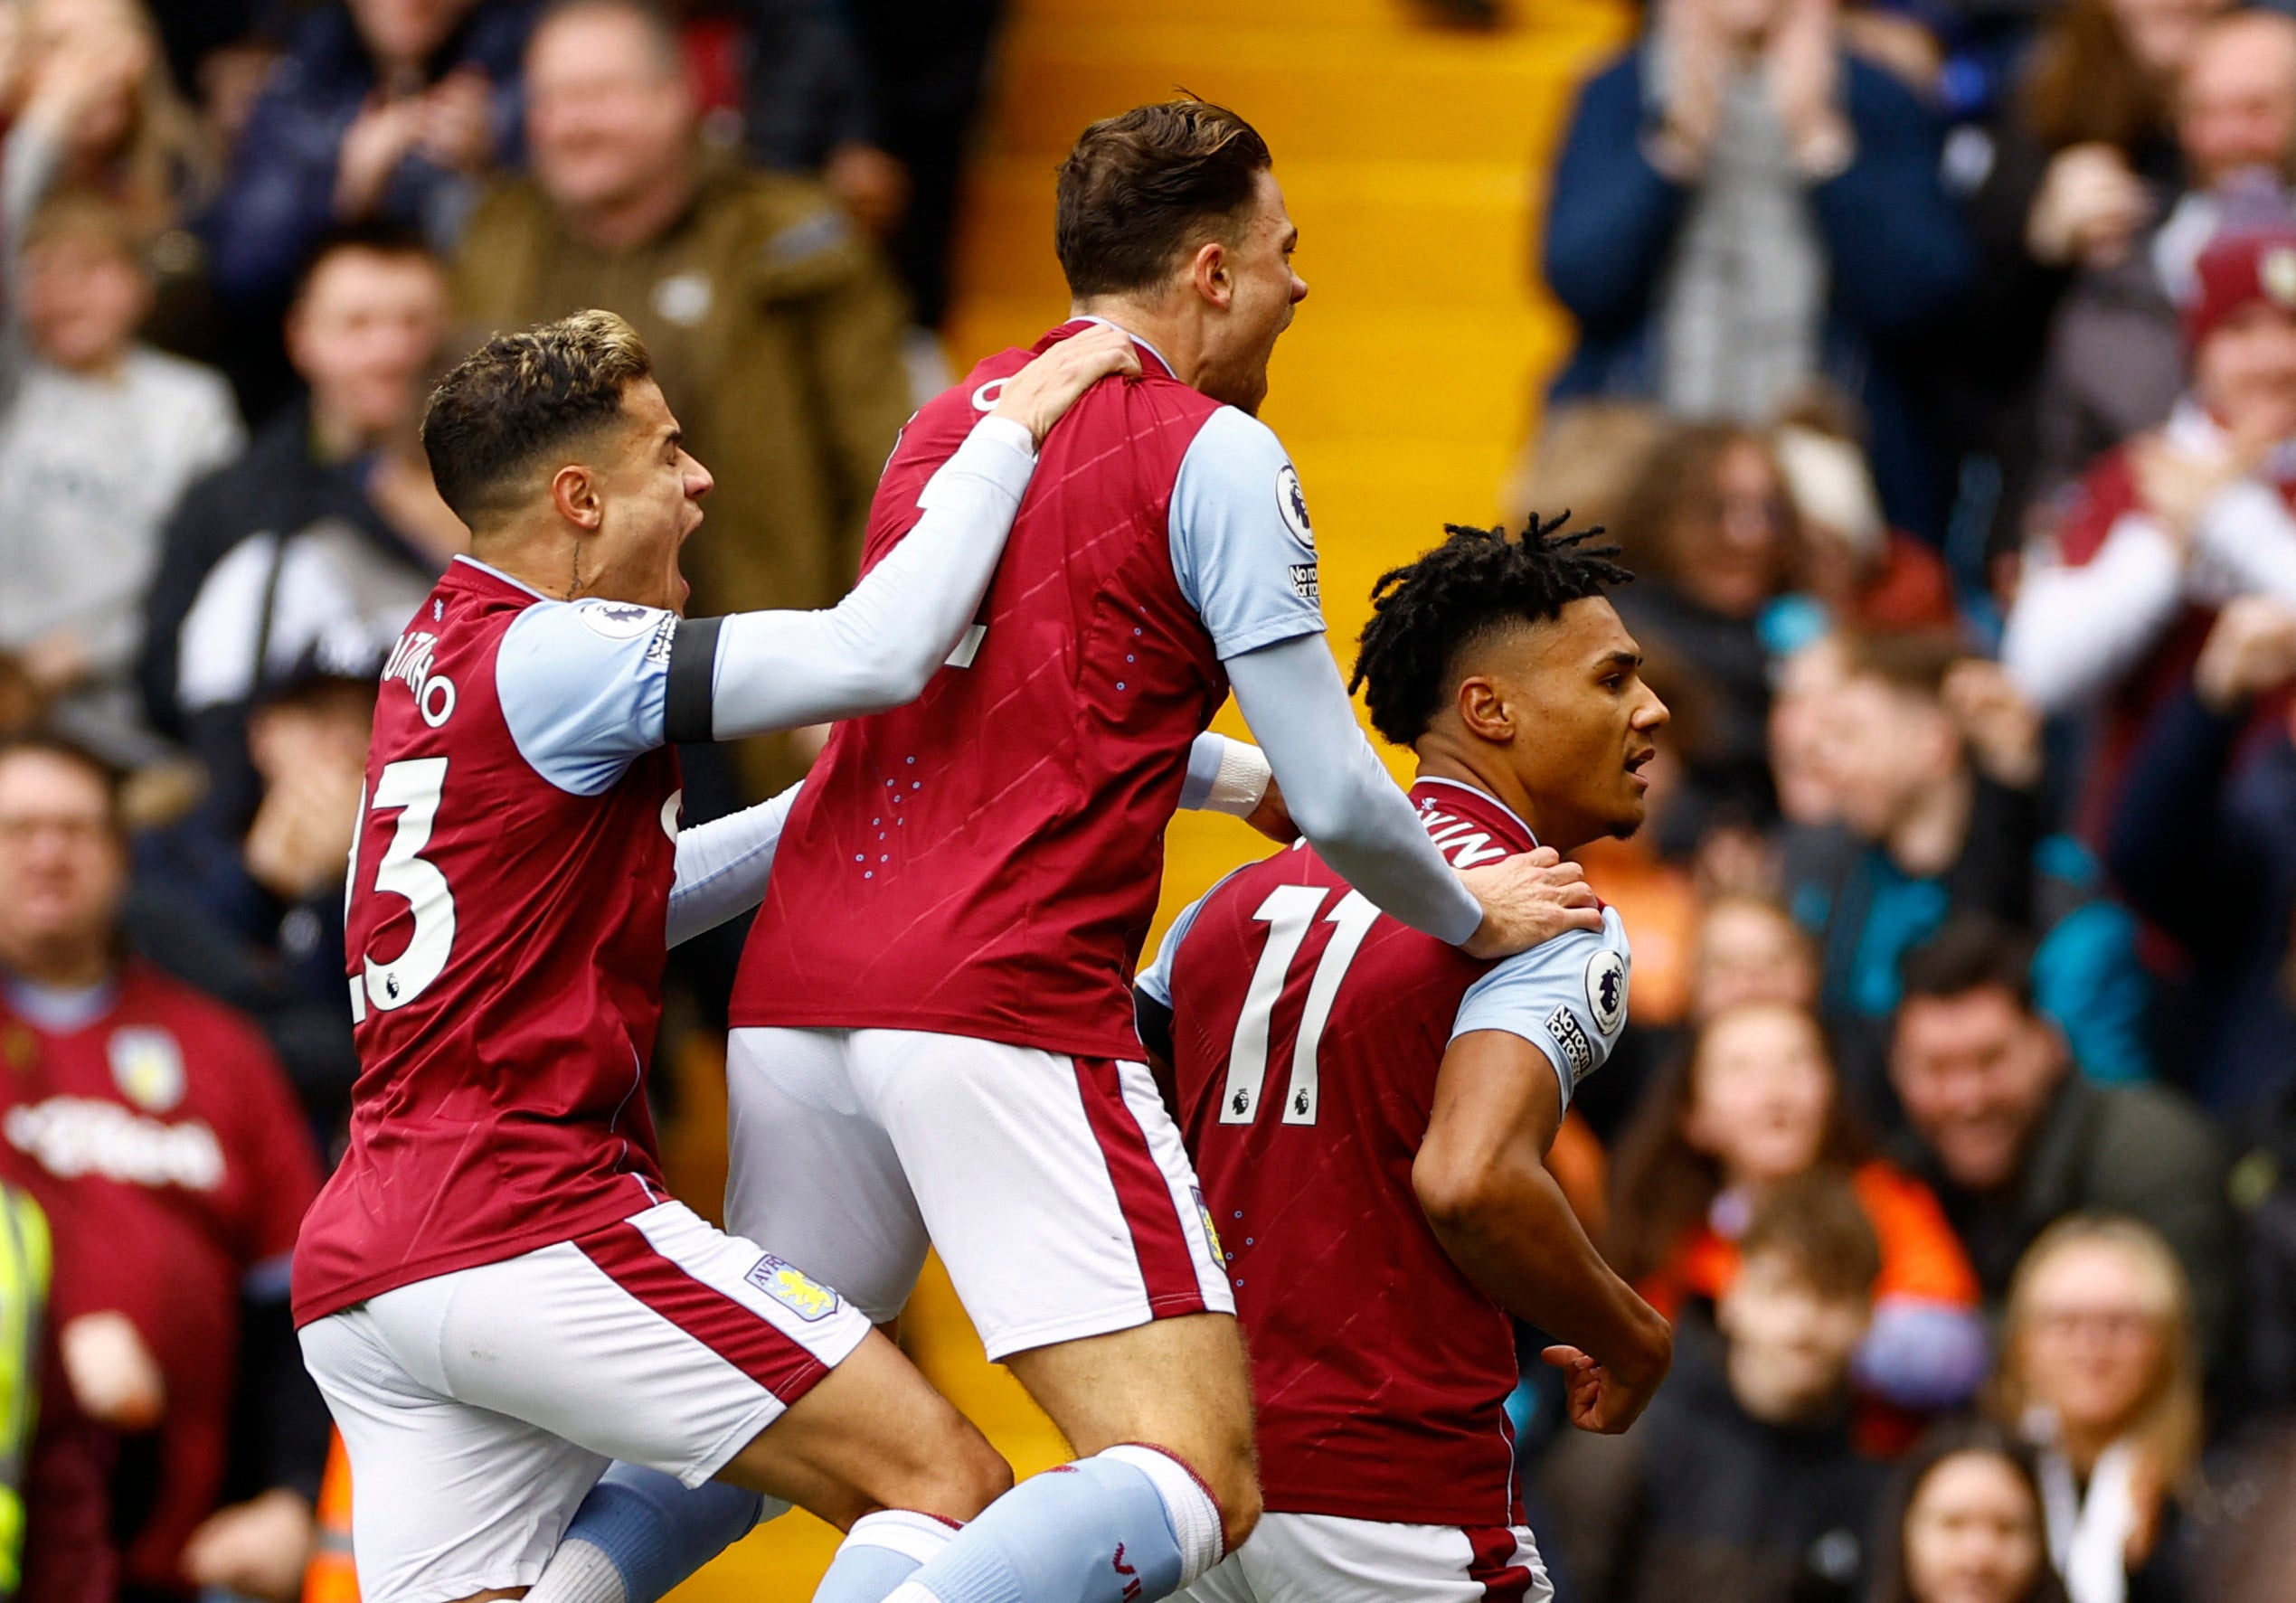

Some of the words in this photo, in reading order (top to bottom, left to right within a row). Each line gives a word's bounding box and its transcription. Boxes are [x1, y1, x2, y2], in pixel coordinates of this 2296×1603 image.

[1290, 566, 1308, 582] No
[1308, 567, 1318, 582] ro
[1218, 883, 1383, 1126] 11
[1545, 1014, 1567, 1041] For
[1553, 1003, 1575, 1033] No
[1571, 1030, 1591, 1070] room
